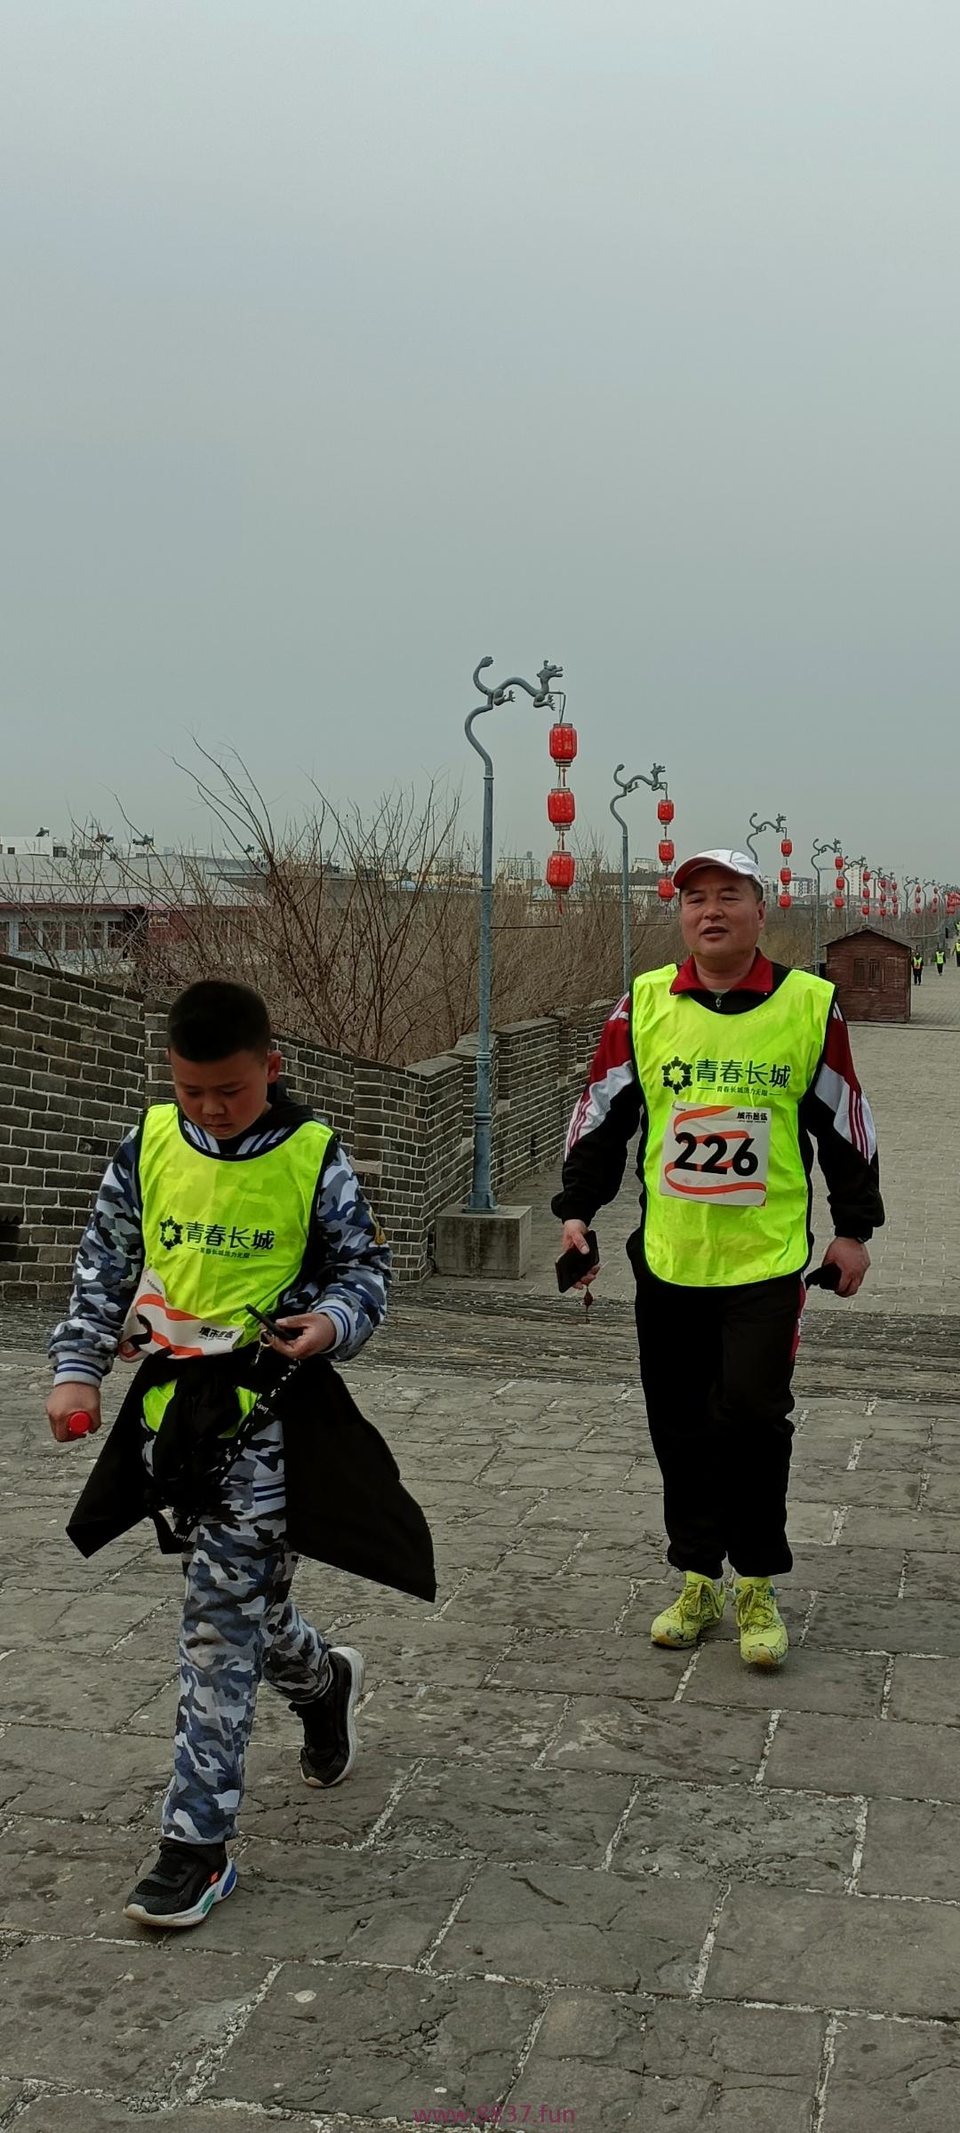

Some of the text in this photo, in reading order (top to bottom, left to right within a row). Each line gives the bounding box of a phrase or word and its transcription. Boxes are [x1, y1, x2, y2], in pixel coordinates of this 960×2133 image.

[695, 1058, 791, 1088] 青春长城
[674, 1132, 759, 1177] 226
[185, 1221, 275, 1250] 青春长城
